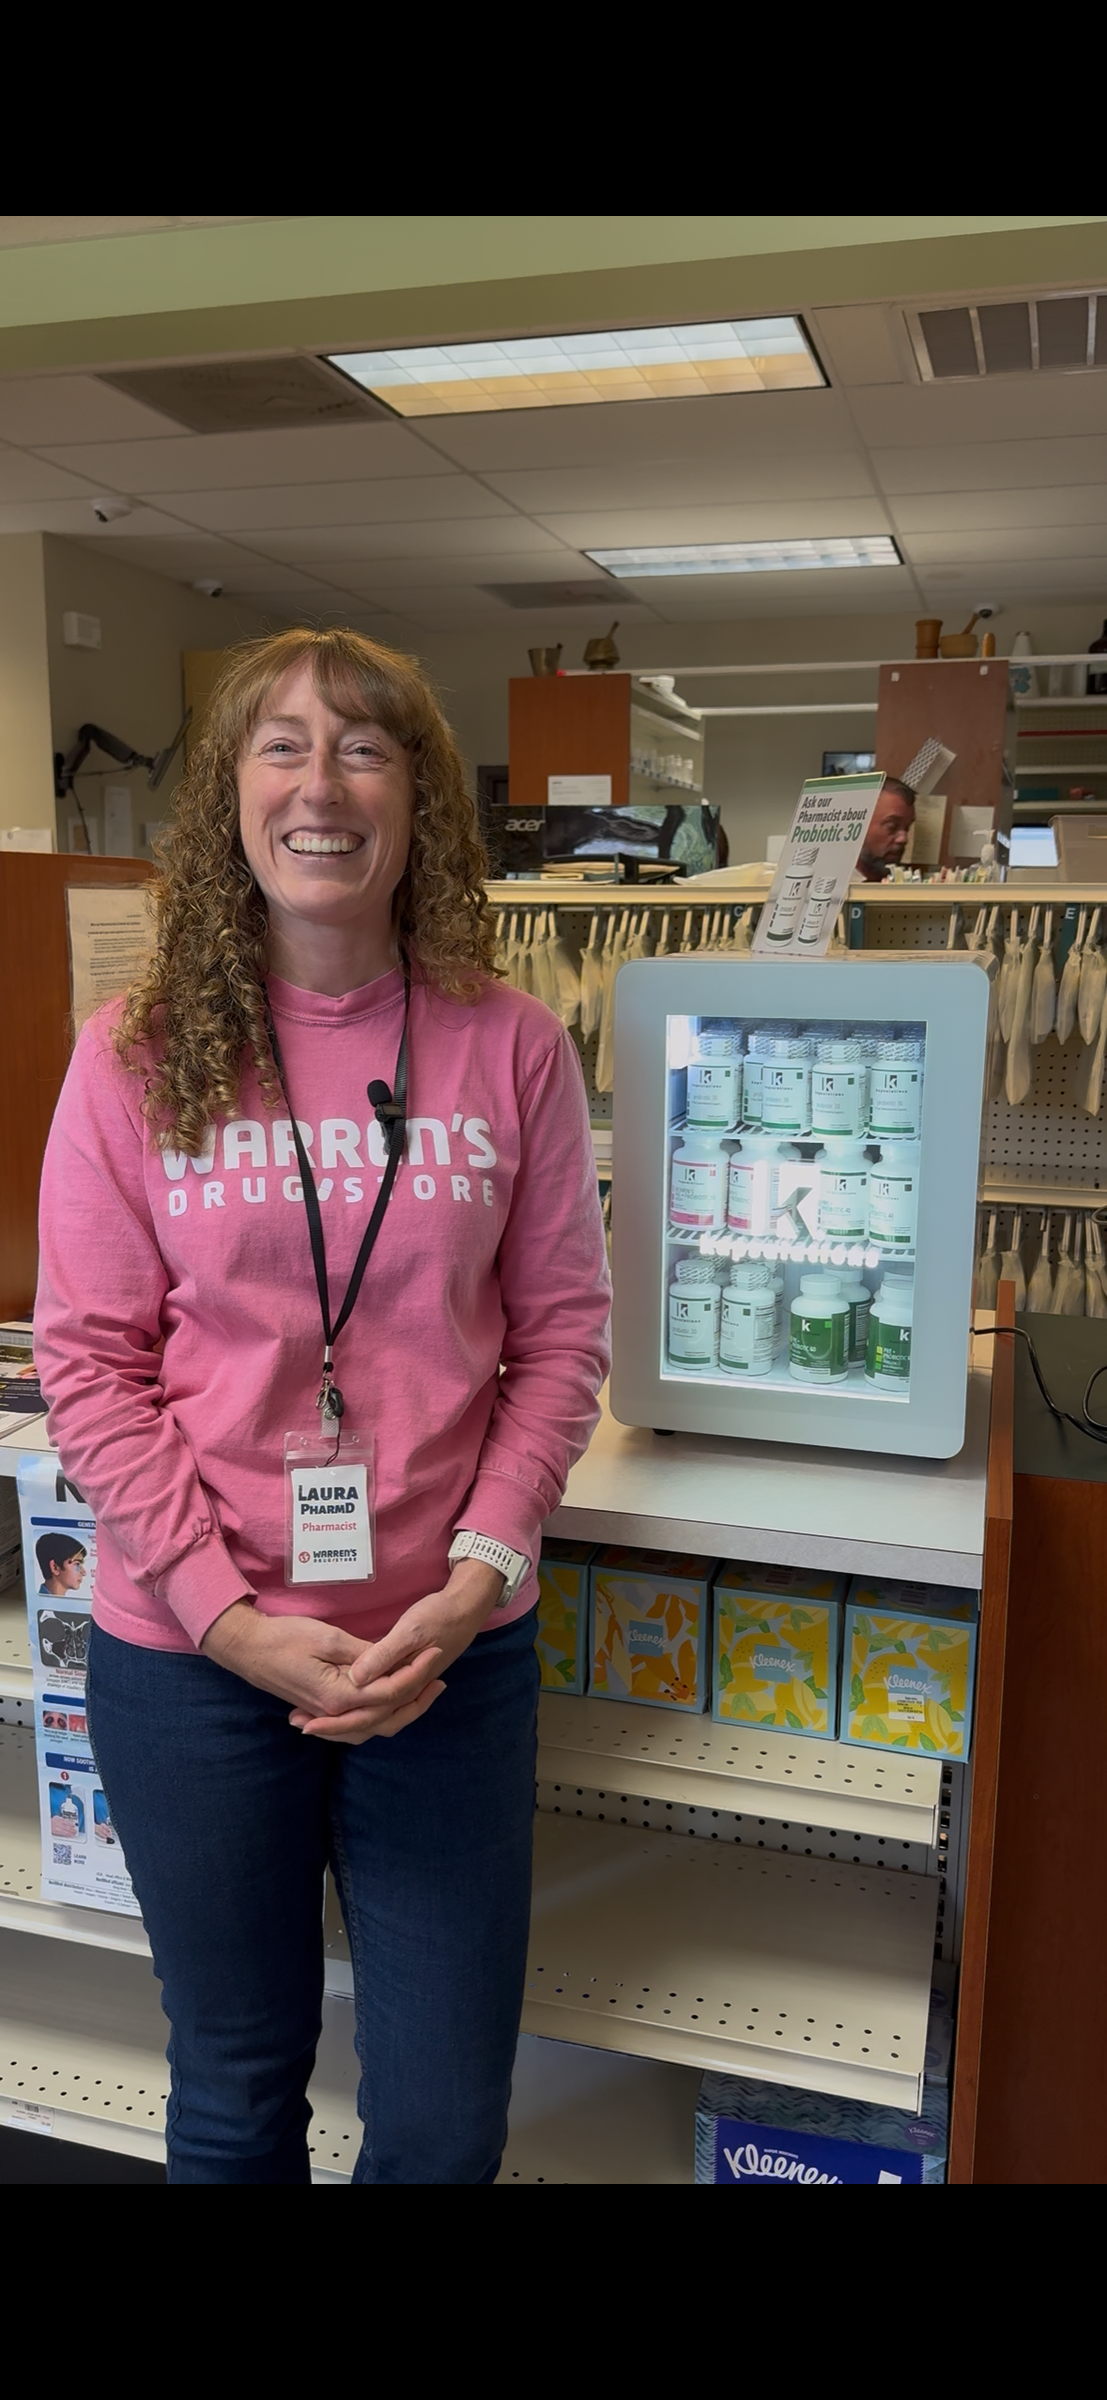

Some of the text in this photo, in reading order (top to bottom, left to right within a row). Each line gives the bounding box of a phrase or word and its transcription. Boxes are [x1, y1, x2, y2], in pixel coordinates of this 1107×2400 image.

[802, 796, 832, 809] Ask our
[797, 808, 868, 824] Pharmacist about
[505, 819, 546, 832] acer
[791, 823, 863, 843] Probiotic 30
[851, 907, 861, 919] D
[1065, 907, 1076, 920] E
[302, 1521, 357, 1532] Pharmacist
[313, 1549, 357, 1558] WARREN'S
[626, 1629, 667, 1649] Kleenex
[750, 1653, 796, 1673] Kleenex
[883, 1674, 932, 1695] Kleenex
